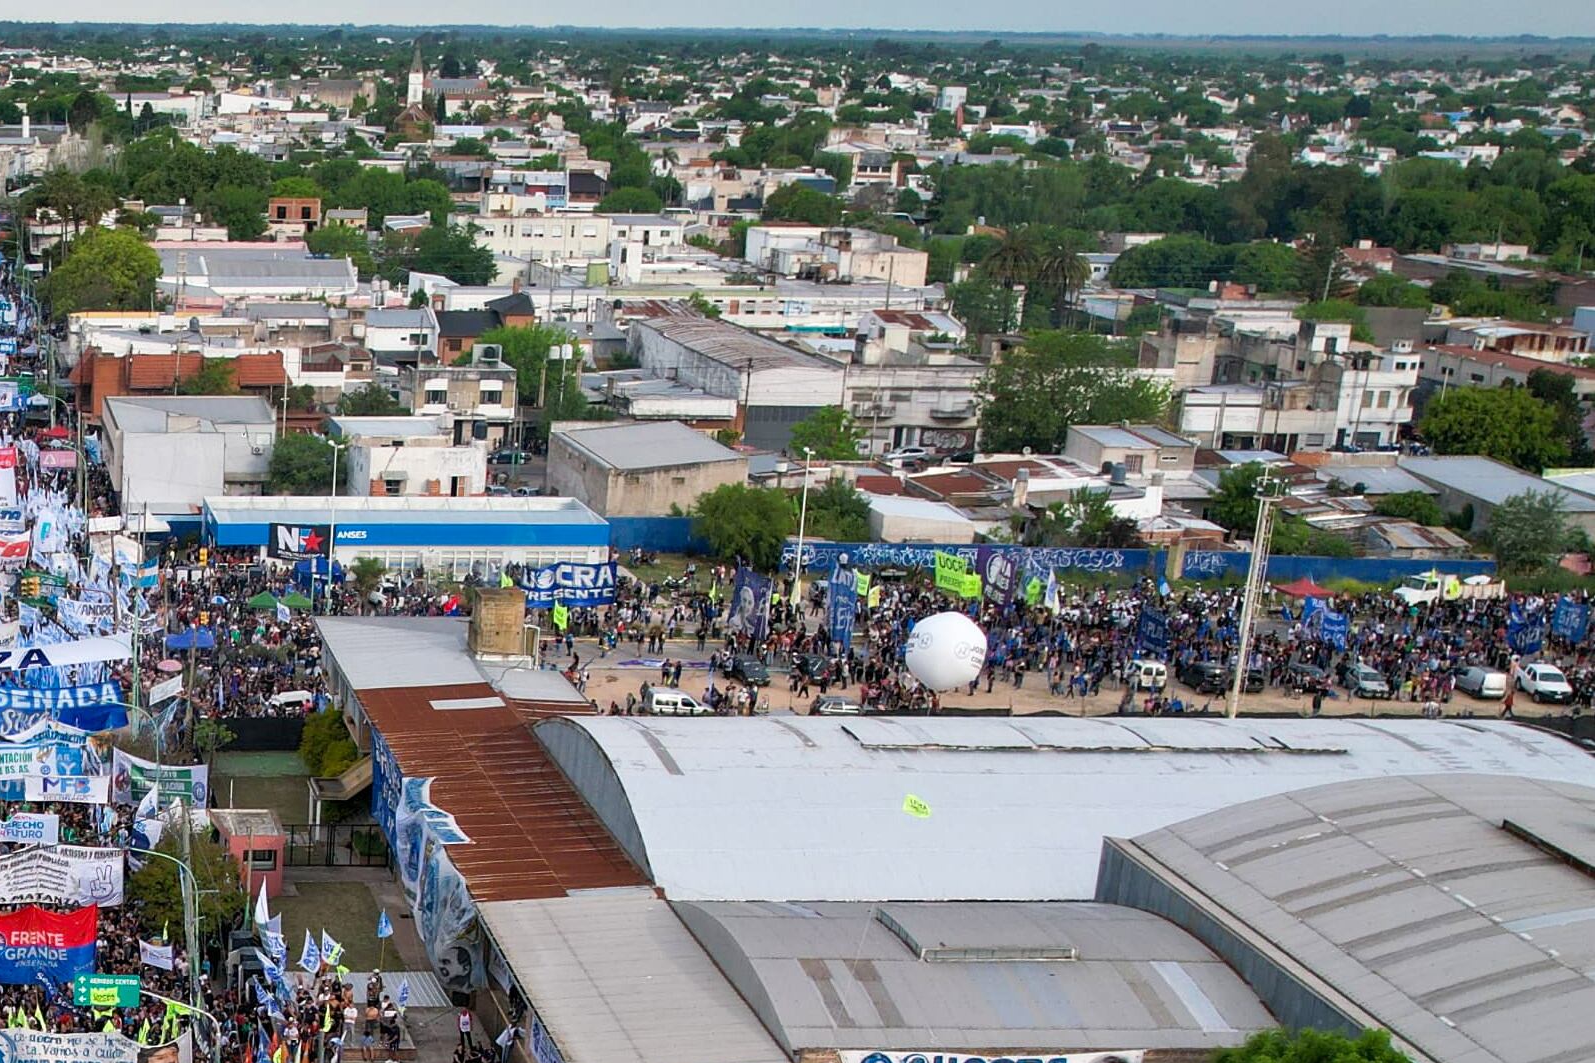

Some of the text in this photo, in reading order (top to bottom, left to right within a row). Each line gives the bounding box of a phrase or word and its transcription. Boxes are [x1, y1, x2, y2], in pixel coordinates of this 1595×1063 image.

[336, 530, 368, 539] ANSES
[6, 828, 43, 839] FUTURO
[12, 893, 80, 906] MATANZA
[11, 931, 64, 946] FRENTE
[5, 947, 68, 961] GRANDE
